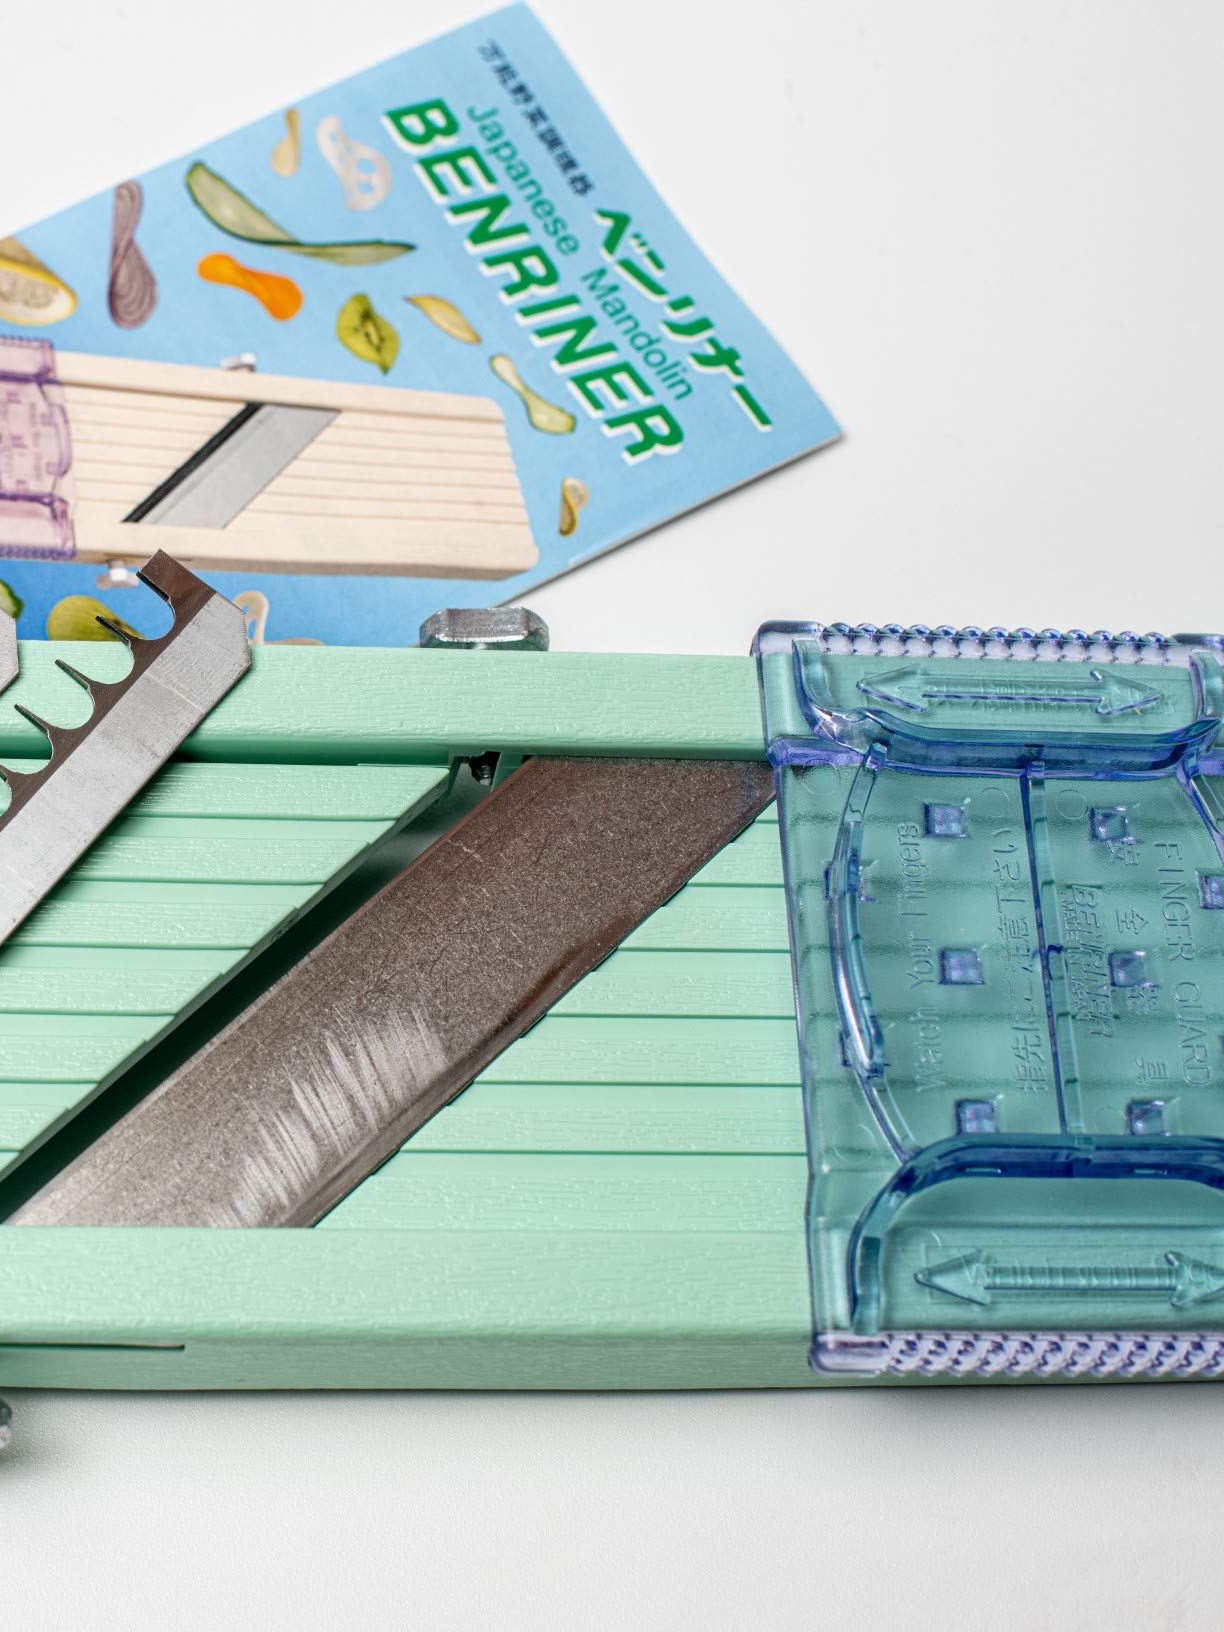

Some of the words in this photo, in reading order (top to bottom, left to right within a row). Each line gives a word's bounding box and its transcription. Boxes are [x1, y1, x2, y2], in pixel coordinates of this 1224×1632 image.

[382, 97, 685, 464] BENRINER
[466, 104, 581, 255] Japanese
[581, 267, 694, 400] Mandolin
[594, 207, 772, 430] ベンリナー
[897, 823, 929, 917] Fingers
[1060, 900, 1078, 940] MADE
[906, 931, 935, 991] Your
[1071, 886, 1113, 1039] BENRINER
[1154, 843, 1195, 962] FINGER
[1175, 981, 1210, 1086] GUARD
[910, 1006, 946, 1094] Watch
